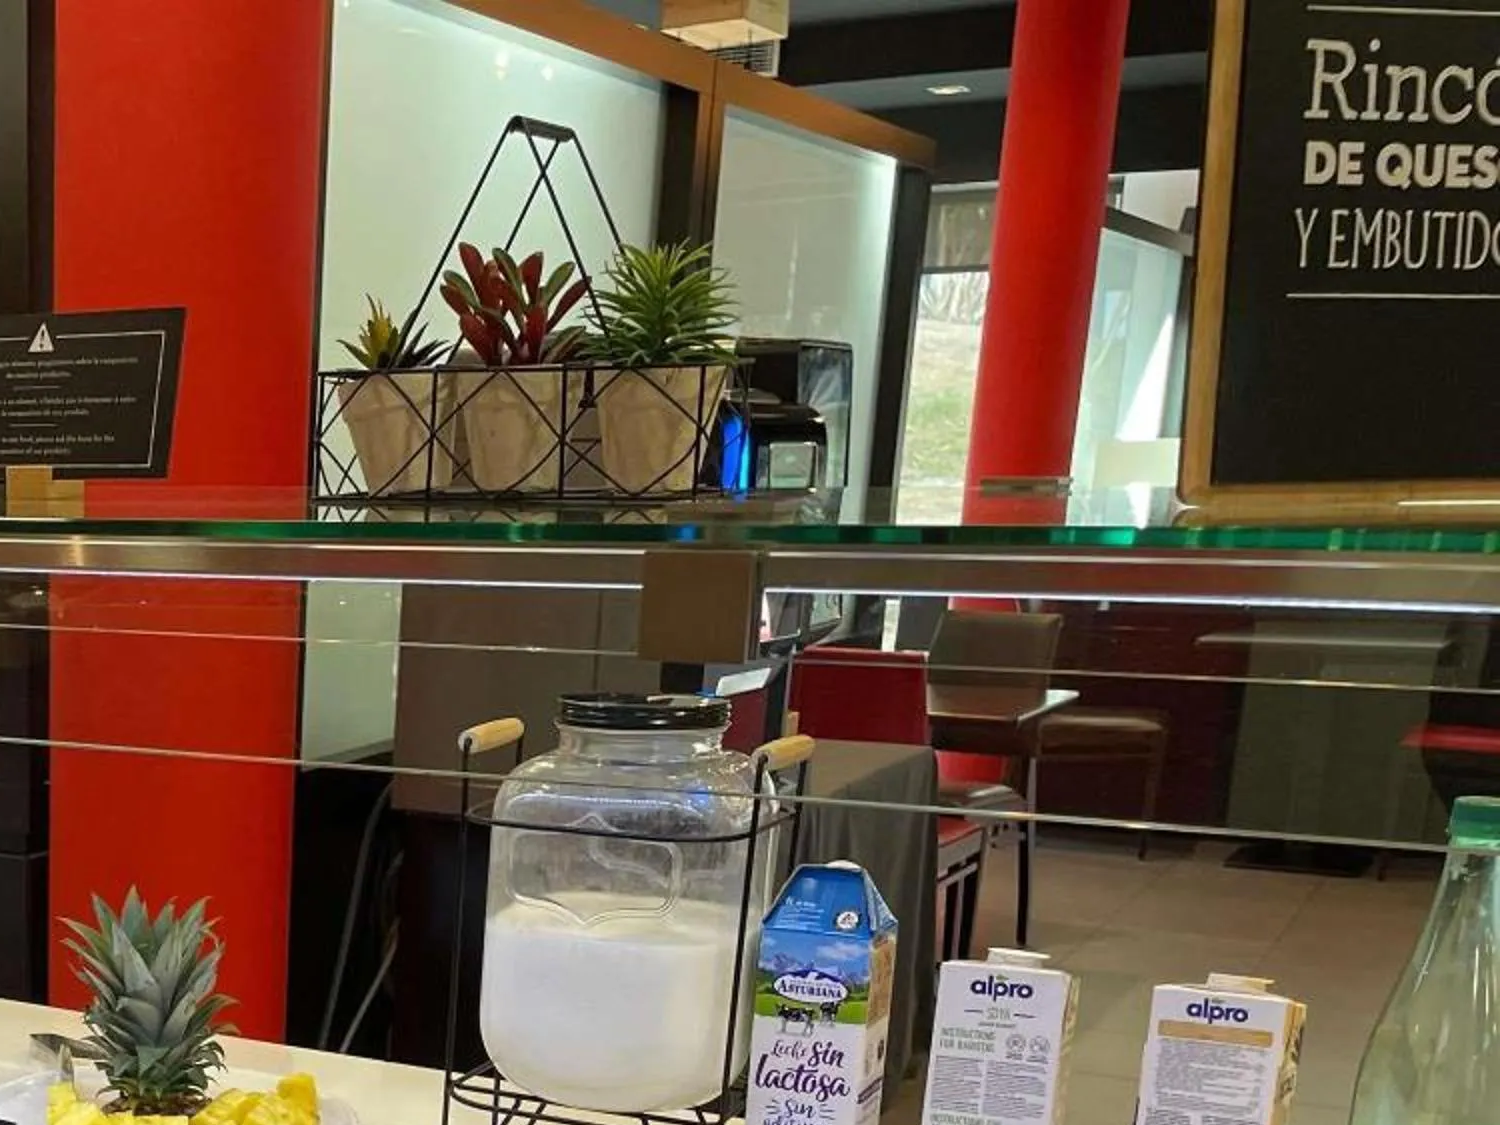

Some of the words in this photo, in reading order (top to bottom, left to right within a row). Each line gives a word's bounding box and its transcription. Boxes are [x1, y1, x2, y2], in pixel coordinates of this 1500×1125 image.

[1304, 141, 1365, 186] DE
[1376, 142, 1500, 190] QUES
[1295, 208, 1319, 269] Y
[779, 979, 843, 998] ASTURIANA
[970, 974, 1033, 1002] alpro
[1186, 997, 1249, 1024] alpro
[755, 1053, 851, 1103] lactosa
